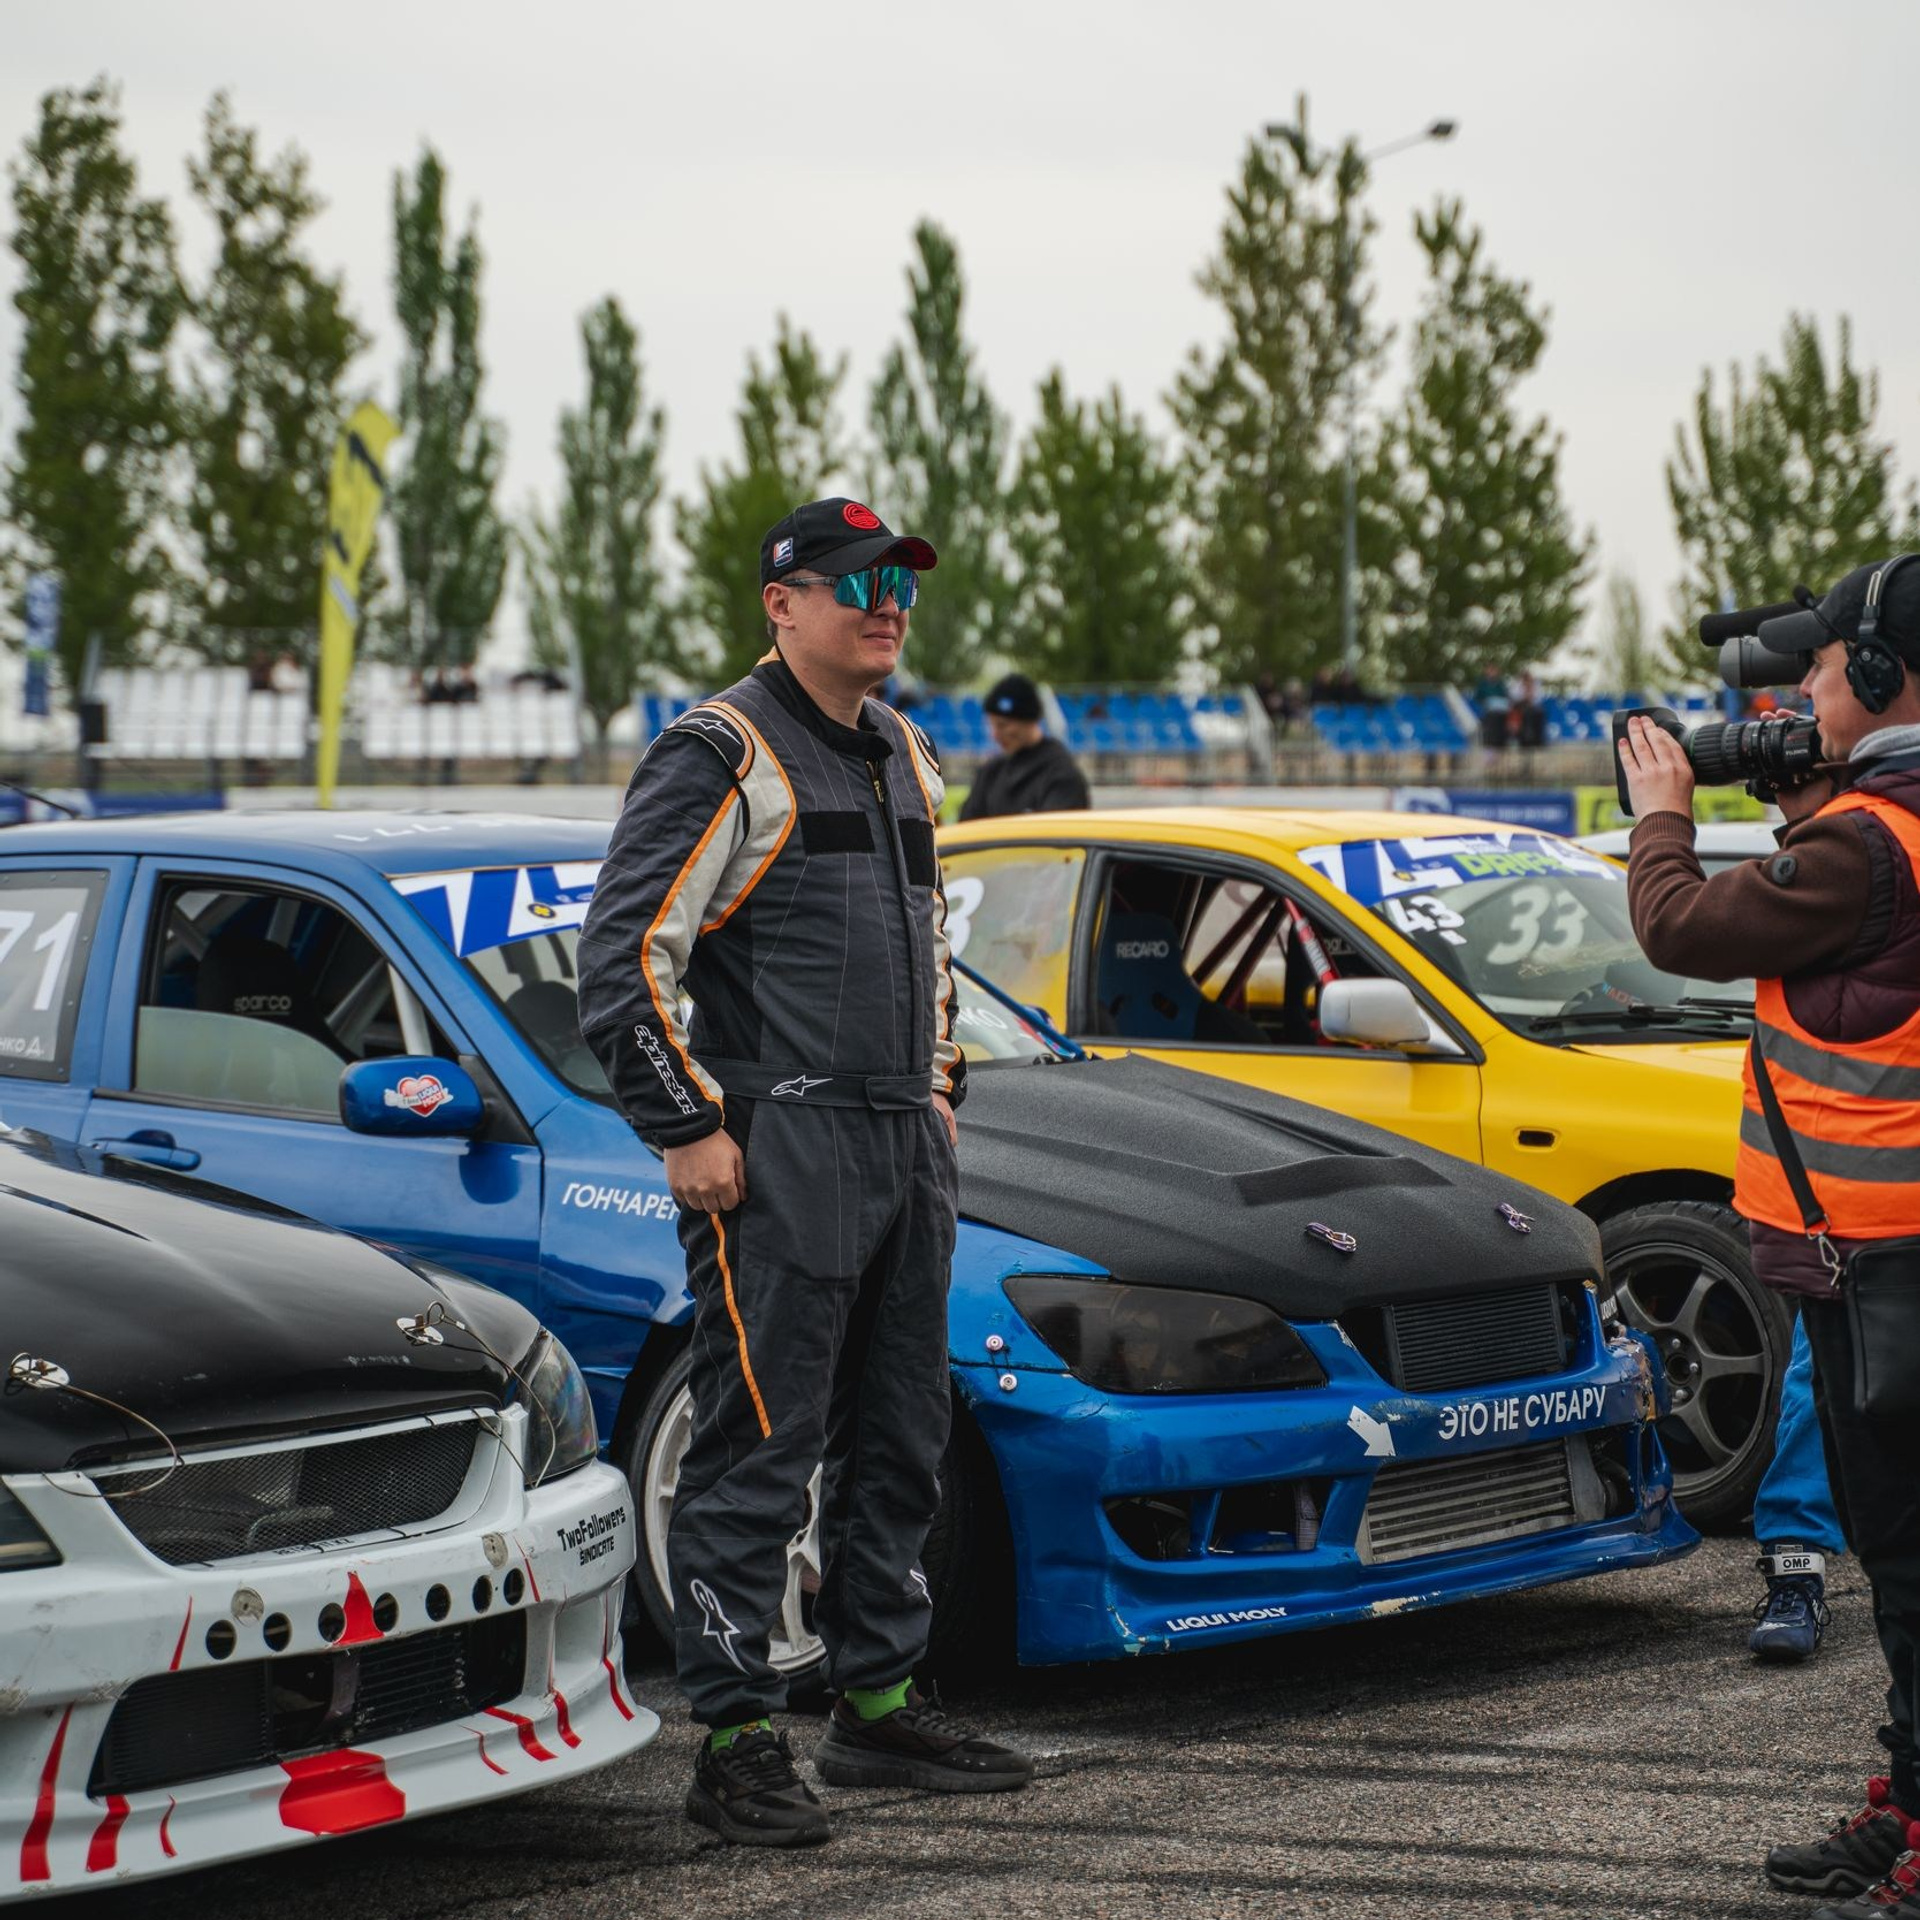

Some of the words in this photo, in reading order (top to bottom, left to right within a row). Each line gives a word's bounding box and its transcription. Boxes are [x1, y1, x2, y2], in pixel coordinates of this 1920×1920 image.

[1387, 895, 1465, 933] 43
[1116, 941, 1169, 958] RECARO
[1438, 1402, 1488, 1440] ЭТО
[1493, 1397, 1520, 1432] НЕ
[1524, 1385, 1606, 1428] СУБАРУ
[557, 1506, 626, 1552] TwoFollowers
[1783, 1558, 1810, 1569] OMP
[1166, 1613, 1230, 1632] LIQUI
[1228, 1607, 1288, 1622] MOLY
